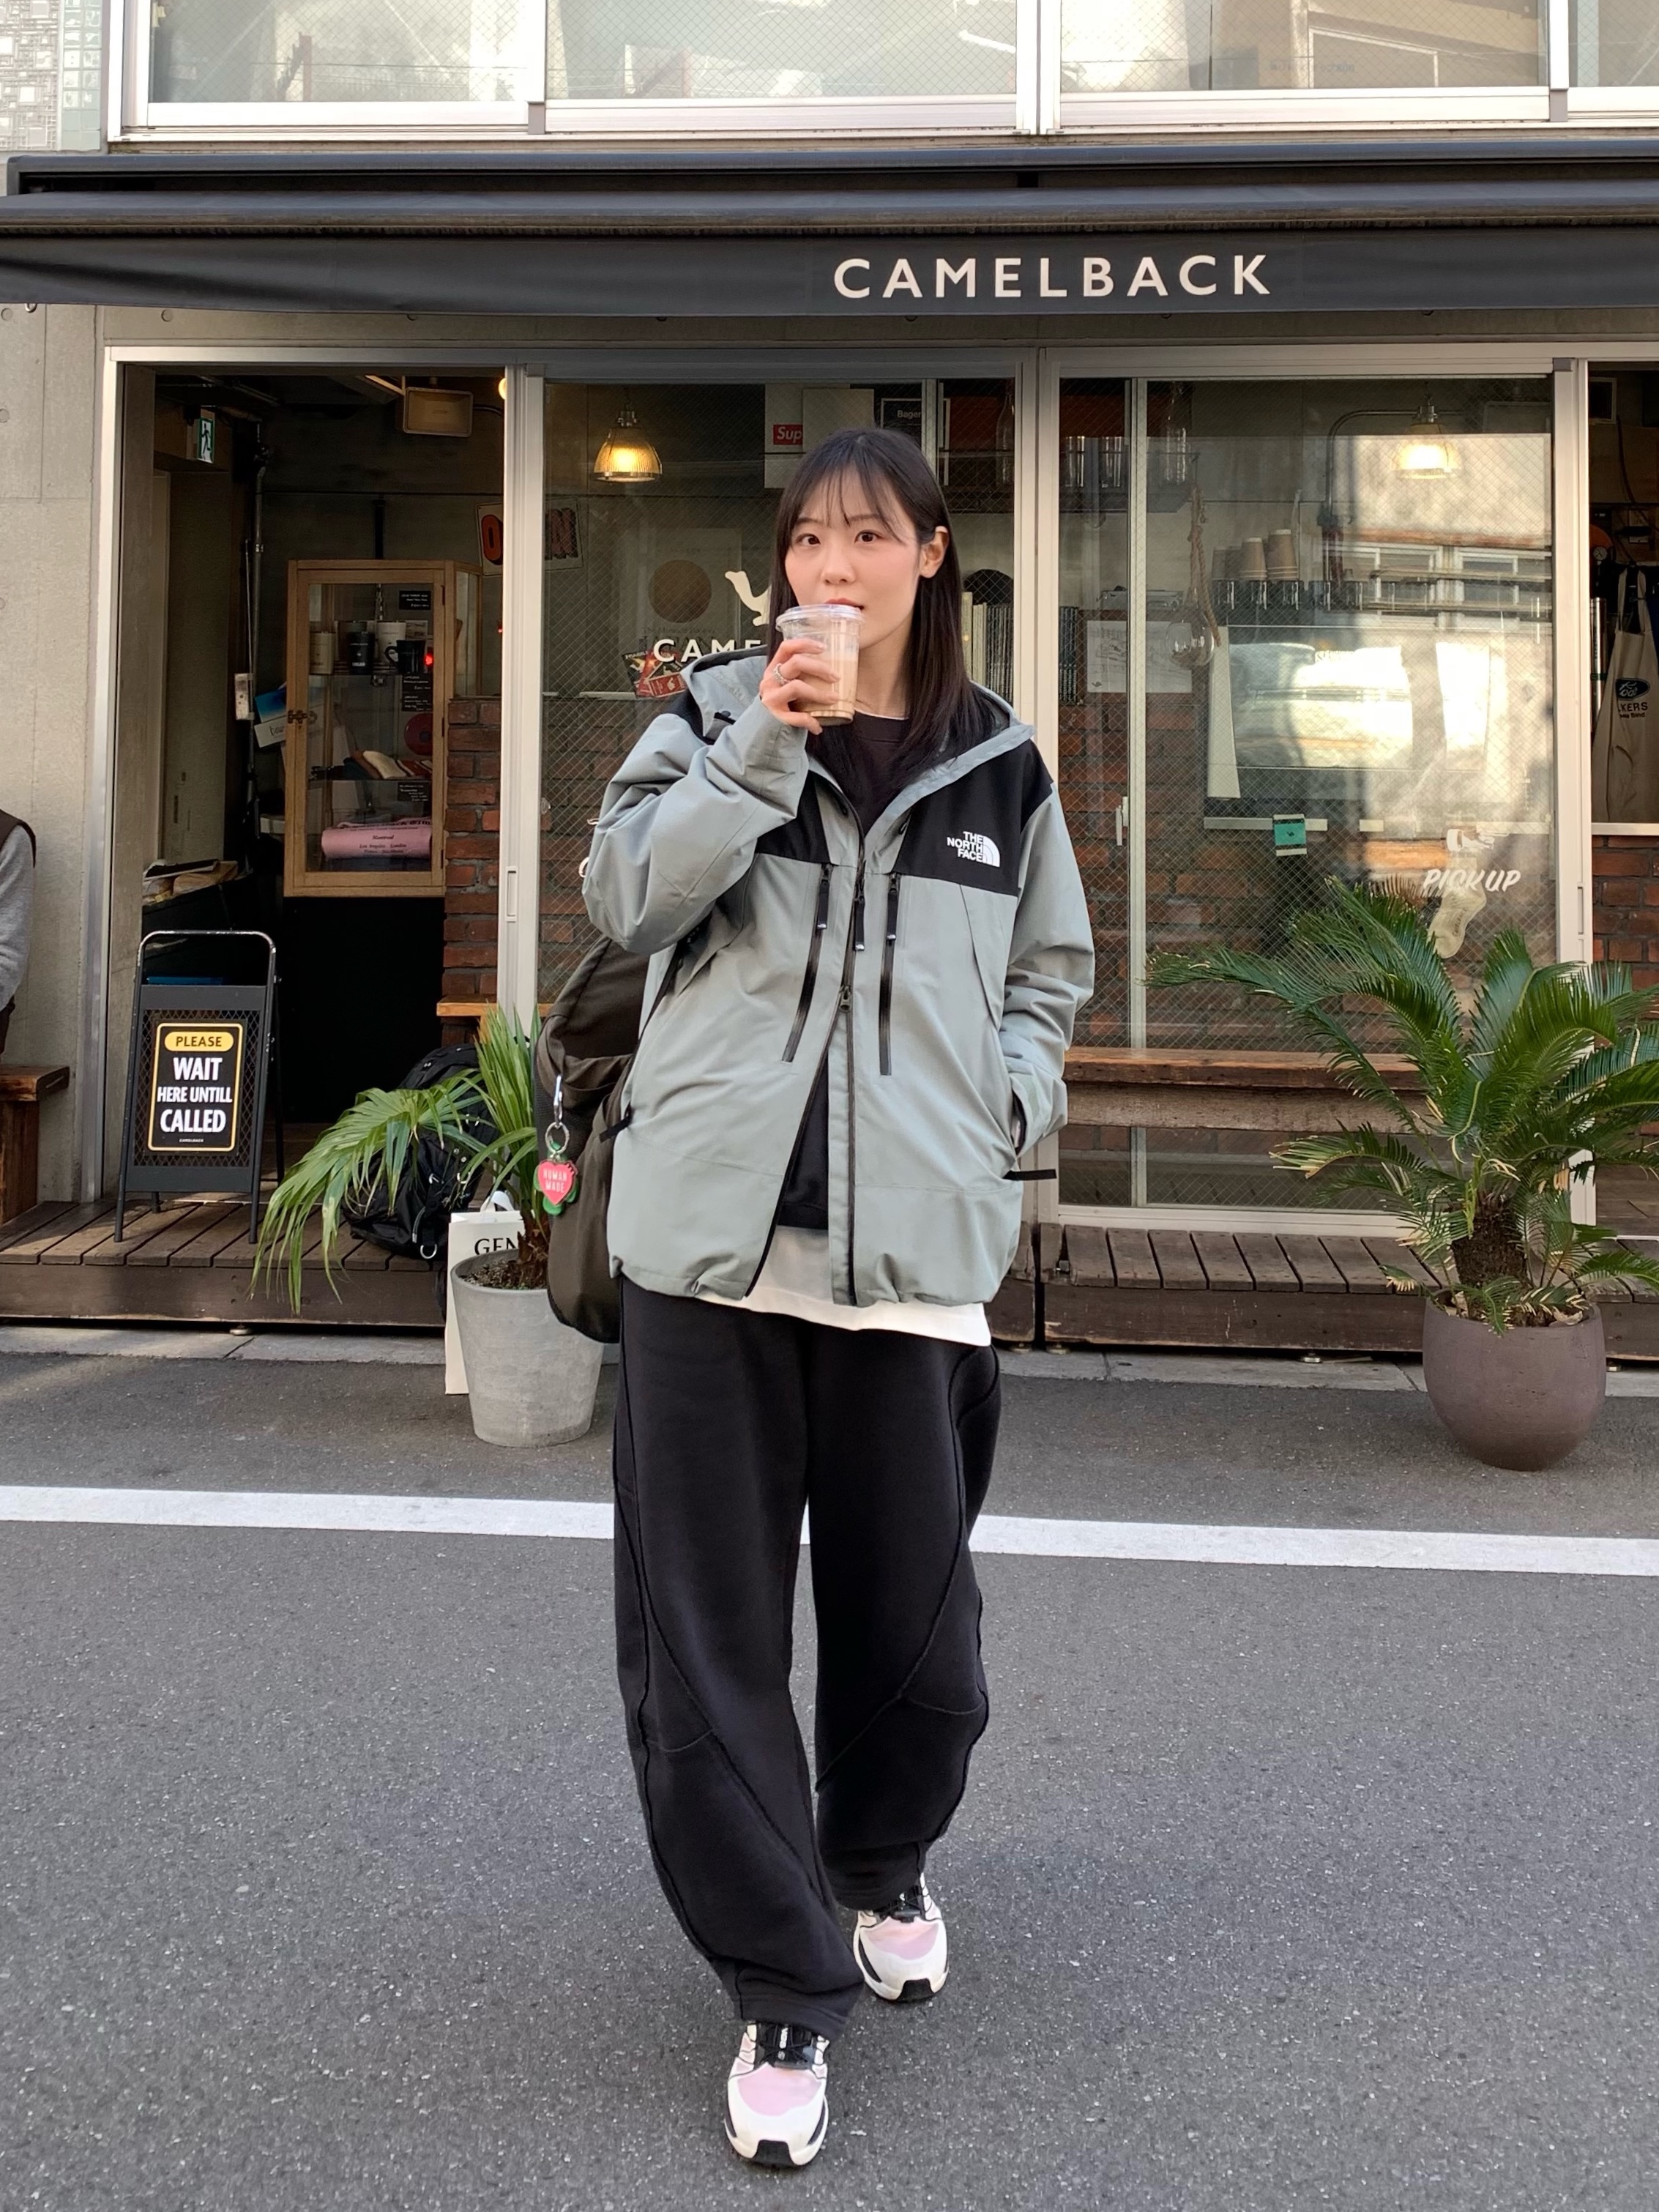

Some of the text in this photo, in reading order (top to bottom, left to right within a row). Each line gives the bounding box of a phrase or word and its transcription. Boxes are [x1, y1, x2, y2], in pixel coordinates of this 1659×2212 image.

[834, 255, 1270, 298] CAMELBACK
[777, 427, 802, 444] Sup
[1618, 702, 1648, 712] KERS
[963, 831, 983, 844] THE
[947, 837, 983, 854] NORTH
[958, 848, 983, 863] FACE
[176, 1036, 222, 1047] PLEASE
[173, 1057, 223, 1081] WAIT
[157, 1087, 233, 1103] HERE UNTILL
[160, 1109, 227, 1133] CALLED
[543, 1168, 567, 1182] HUMAN
[545, 1180, 565, 1193] MADE
